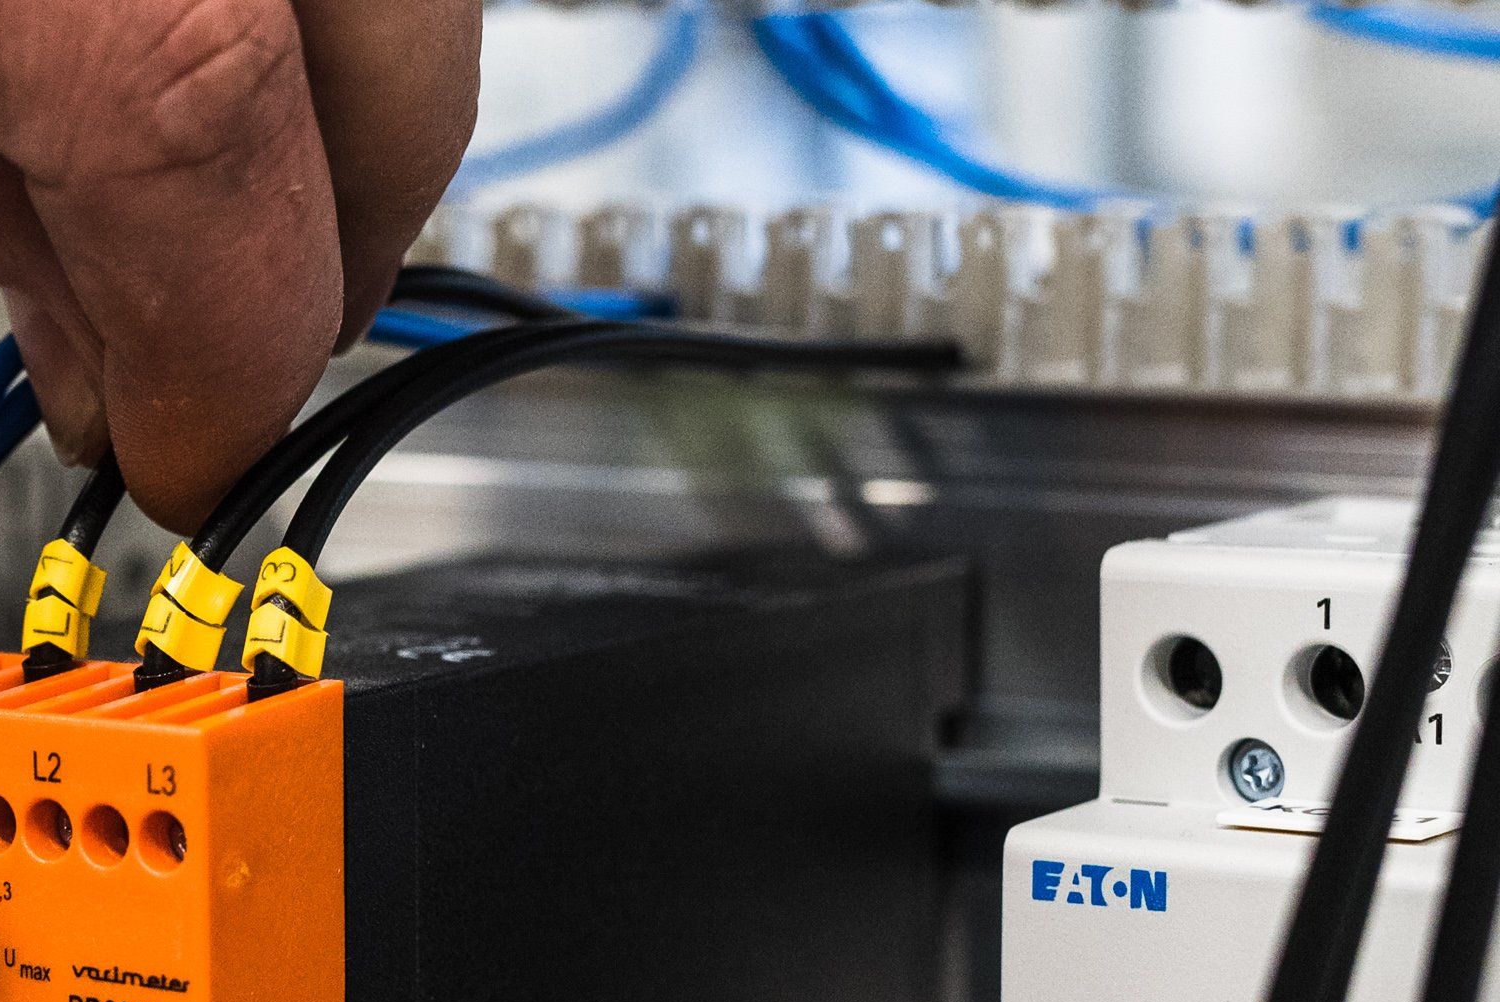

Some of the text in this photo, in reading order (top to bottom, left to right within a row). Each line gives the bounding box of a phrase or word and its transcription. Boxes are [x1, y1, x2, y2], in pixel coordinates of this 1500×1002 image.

[1316, 597, 1331, 630] 1
[33, 750, 62, 784] L2
[146, 763, 177, 797] L3
[1031, 859, 1168, 913] EATON
[72, 964, 190, 993] varimeter
